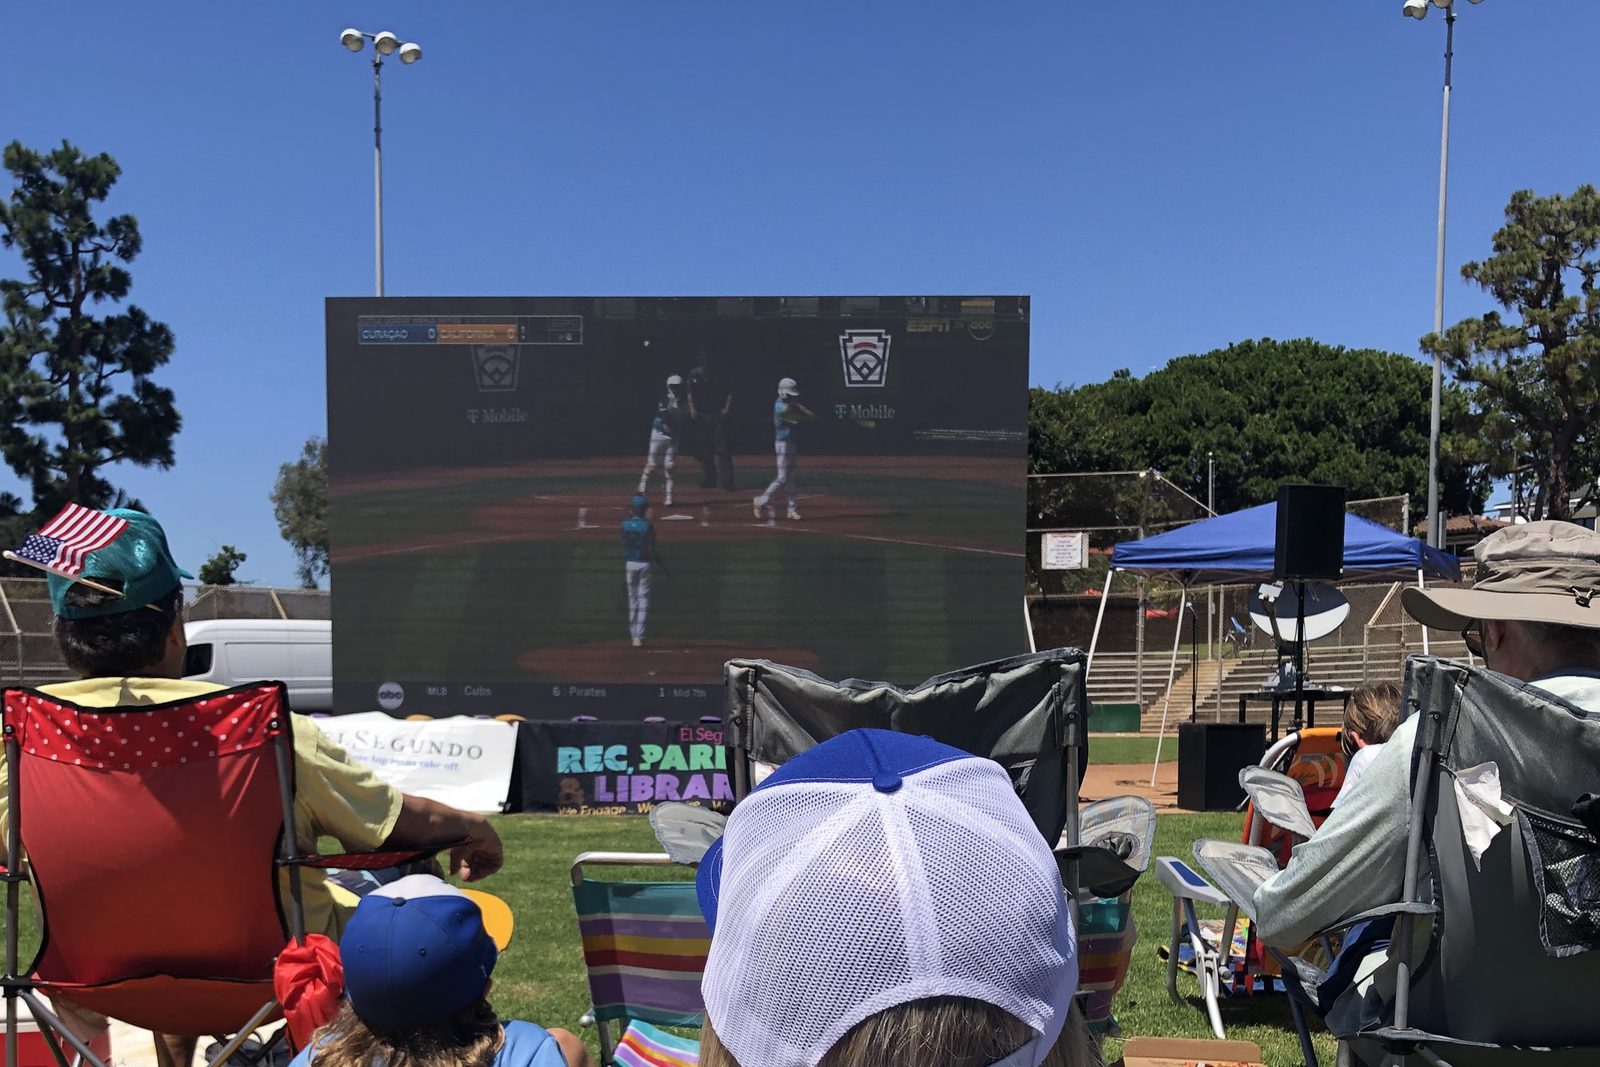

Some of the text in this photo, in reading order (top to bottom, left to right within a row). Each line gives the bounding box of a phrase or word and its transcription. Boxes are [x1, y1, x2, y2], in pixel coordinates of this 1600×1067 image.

[427, 328, 436, 340] 0
[507, 328, 516, 339] 0
[849, 404, 897, 420] Mobile
[427, 687, 447, 697] MLB
[463, 686, 561, 697] Cubs 6
[569, 686, 608, 698] Pirates
[680, 727, 724, 744] El Seg
[352, 730, 484, 760] SEGUNDO
[557, 744, 634, 775] REC,
